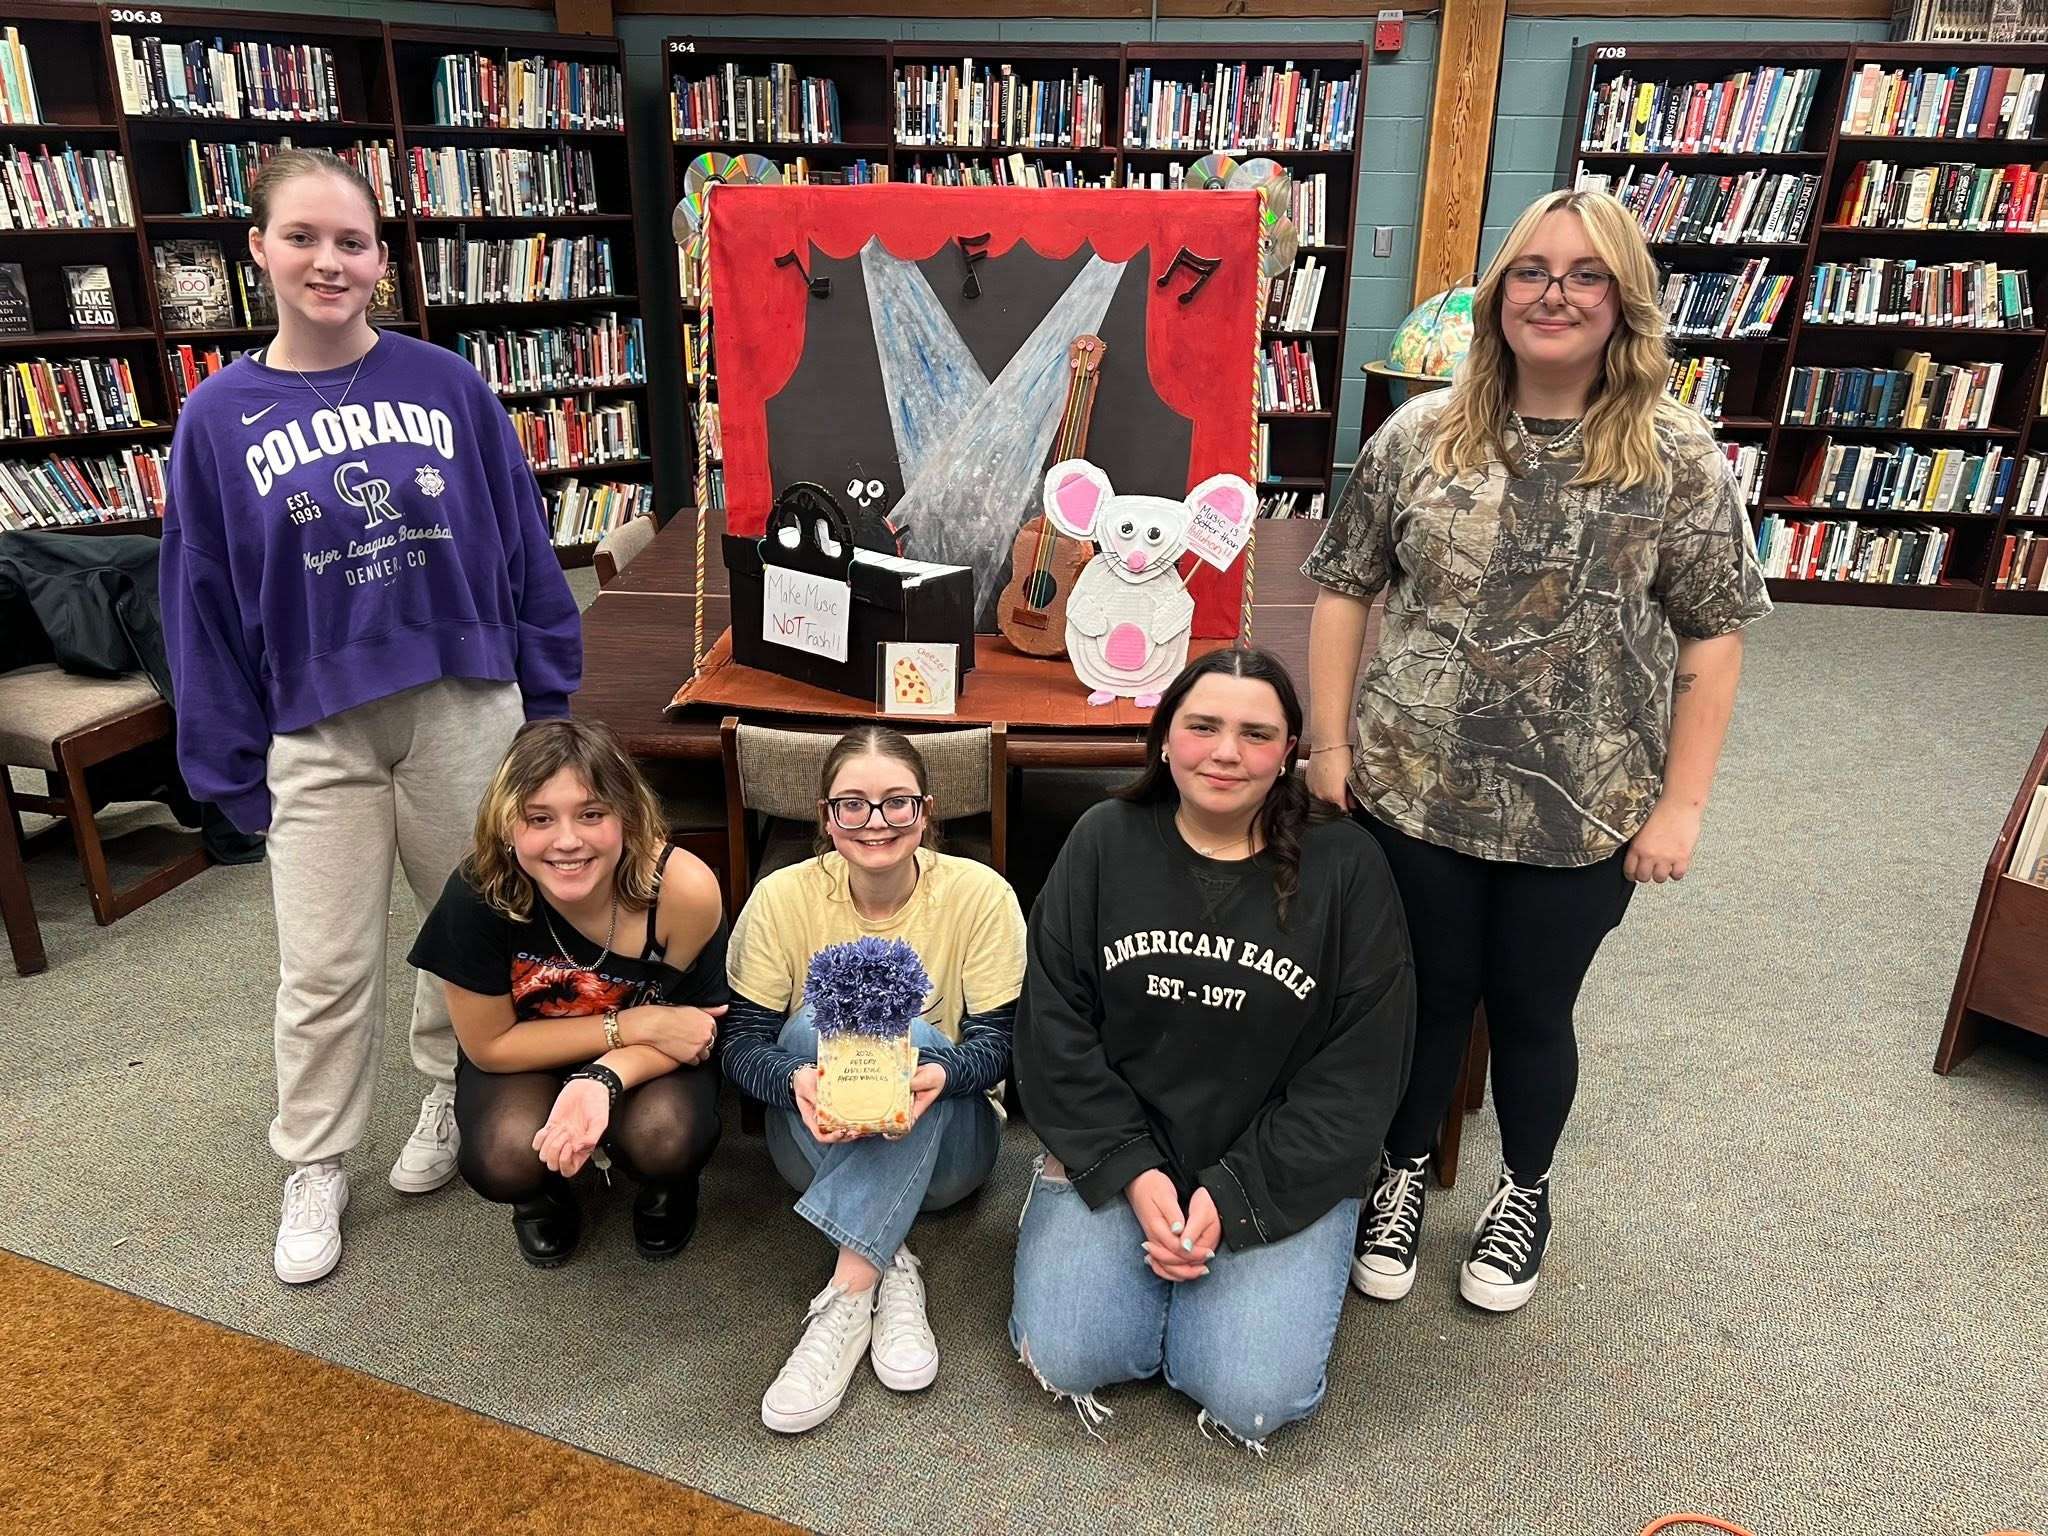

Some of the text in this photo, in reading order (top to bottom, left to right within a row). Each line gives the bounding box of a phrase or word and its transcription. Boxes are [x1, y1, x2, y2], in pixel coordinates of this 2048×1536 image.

[111, 9, 163, 24] 306.8
[669, 42, 695, 53] 364
[1597, 47, 1626, 58] 708
[1666, 105, 1677, 124] DEEP
[178, 280, 206, 292] 100
[76, 310, 115, 325] LEAD
[109, 385, 120, 406] Caste
[1302, 374, 1313, 402] cookies
[245, 401, 455, 497] COLORADO
[286, 492, 315, 511] EST.
[290, 504, 323, 526] 1993
[1199, 504, 1226, 529] Music
[347, 534, 397, 560] League
[407, 549, 427, 568] CO
[767, 574, 839, 617] Make Music
[772, 613, 805, 636] NOT
[1103, 930, 1317, 1000] AMERICAN EAGLE
[1146, 974, 1185, 1000] EST
[1201, 984, 1247, 1012] 1977
